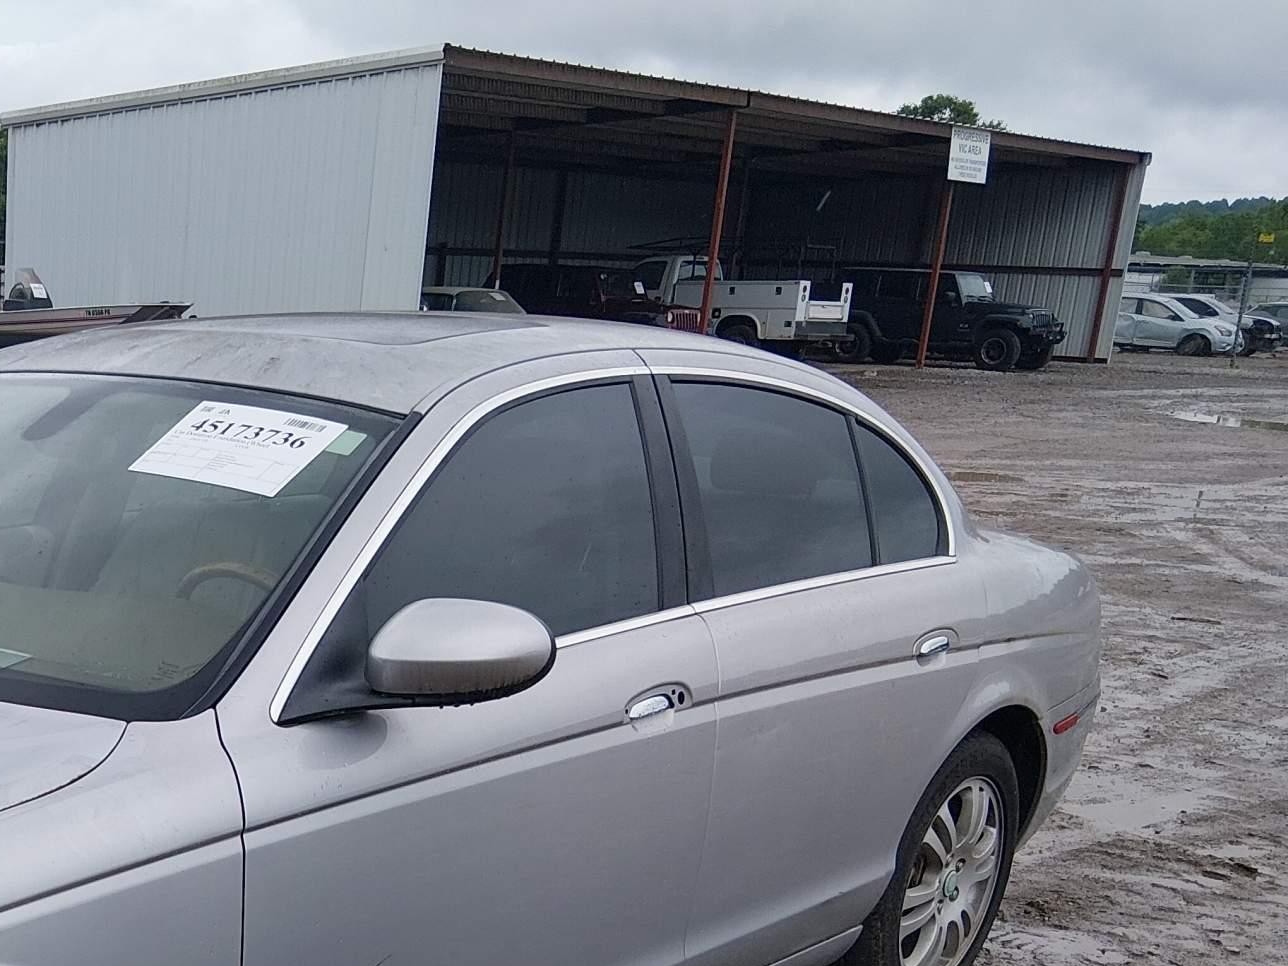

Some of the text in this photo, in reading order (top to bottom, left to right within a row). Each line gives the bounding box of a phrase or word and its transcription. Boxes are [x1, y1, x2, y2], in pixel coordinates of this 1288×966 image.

[953, 128, 989, 144] PROGRESSIVE
[968, 145, 982, 155] AREA
[191, 418, 312, 449] 45173736
